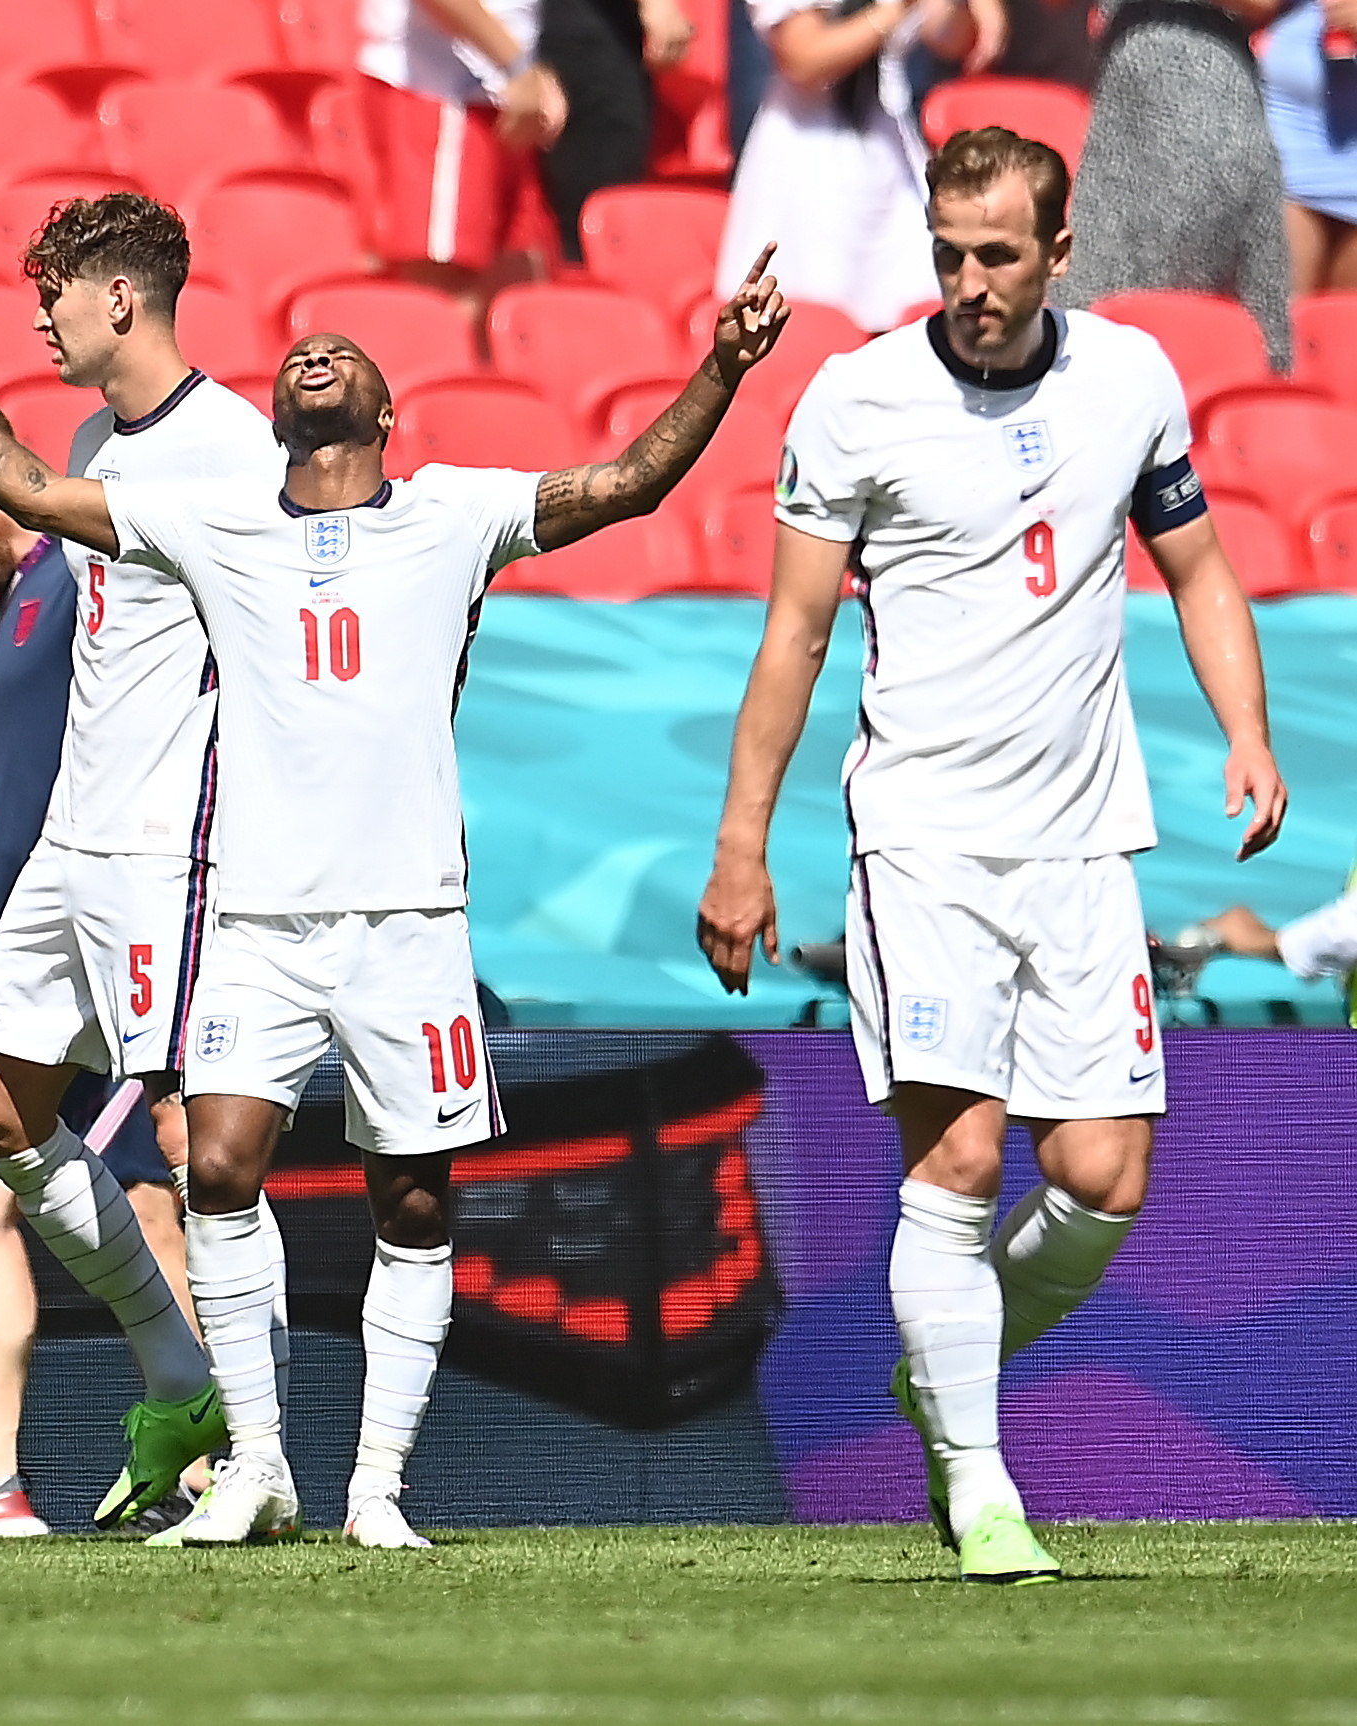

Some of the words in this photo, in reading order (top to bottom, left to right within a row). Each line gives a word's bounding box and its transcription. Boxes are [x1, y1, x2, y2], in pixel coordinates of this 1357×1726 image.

[1024, 519, 1058, 599] 9
[86, 562, 105, 636] 5
[299, 607, 361, 682] 10
[129, 943, 153, 1017] 5
[1132, 973, 1153, 1054] 9
[421, 1014, 477, 1093] 10
